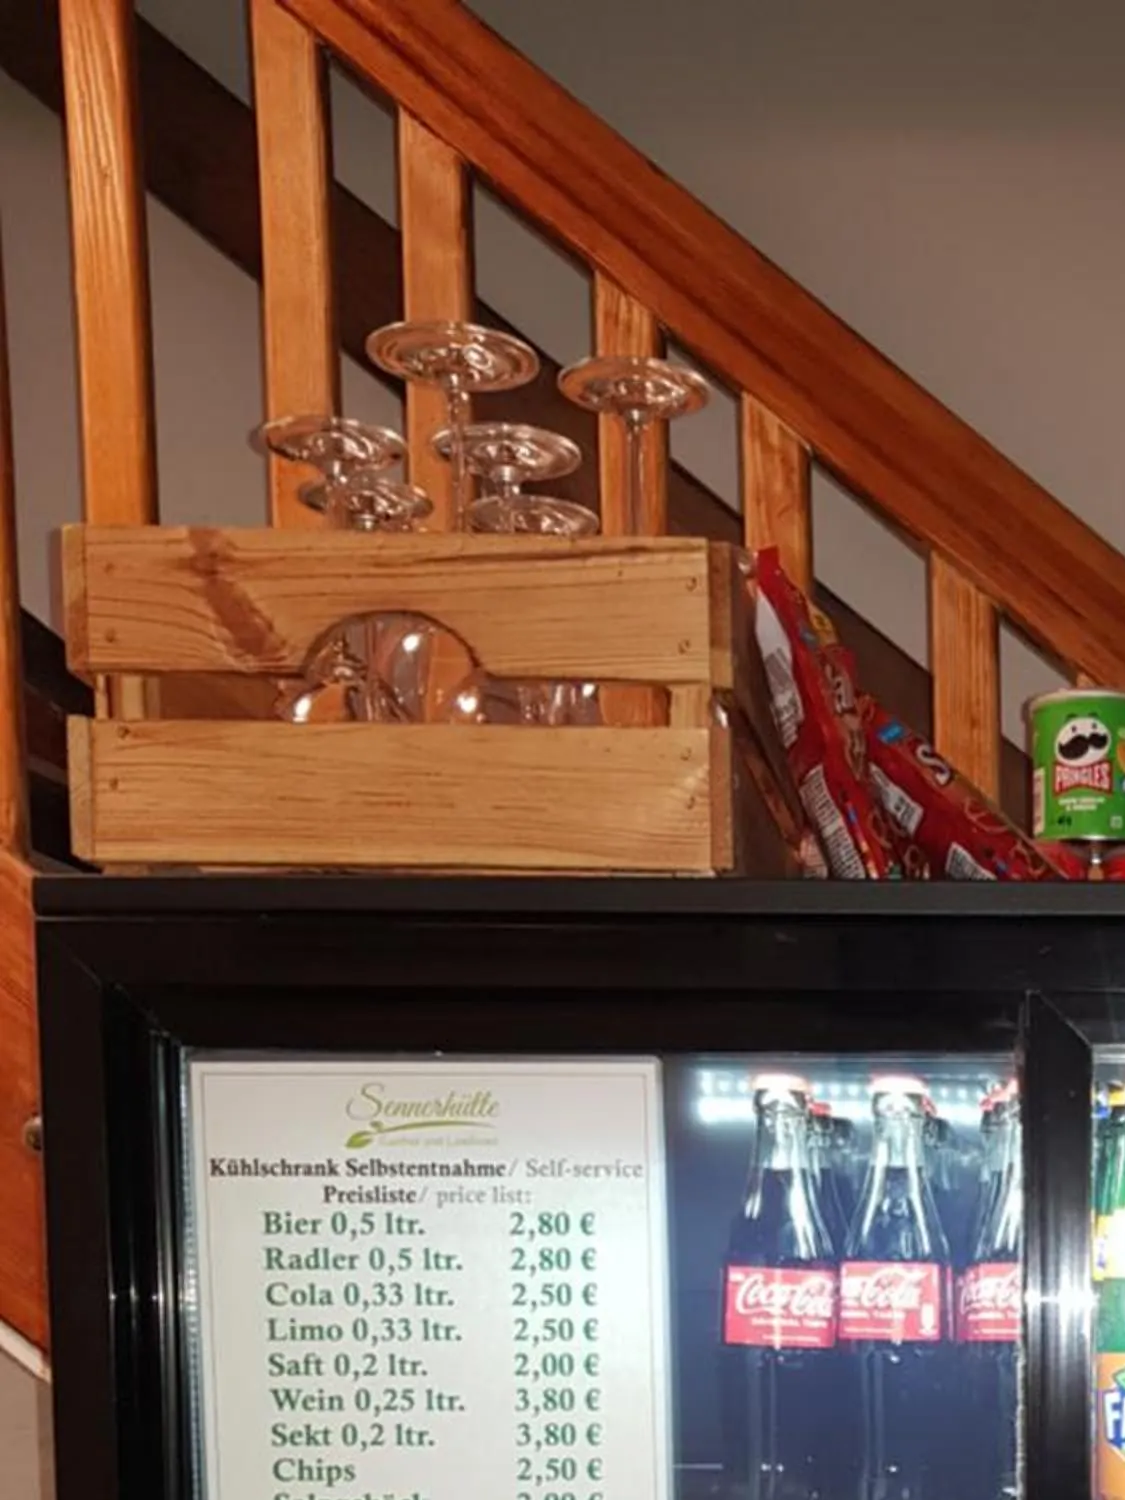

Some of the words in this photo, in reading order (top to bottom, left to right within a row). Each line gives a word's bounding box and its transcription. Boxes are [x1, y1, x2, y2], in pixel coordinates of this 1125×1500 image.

[1055, 762, 1111, 793] PRINGLES
[210, 1158, 341, 1178] Kühlschrank
[526, 1159, 642, 1177] Self-service
[437, 1186, 486, 1206] price
[493, 1186, 530, 1203] list:
[263, 1211, 322, 1235] Bier
[331, 1211, 375, 1241] 0,5
[385, 1211, 425, 1235] ltr.
[510, 1211, 571, 1241] 2,80
[579, 1212, 595, 1236] €
[264, 1247, 360, 1271] Radler
[368, 1247, 412, 1276] 0,5
[423, 1247, 463, 1271] ltr.
[511, 1247, 572, 1276] 2,80
[580, 1247, 596, 1271] €
[265, 1282, 334, 1307] Cola
[343, 1282, 404, 1311] 0,33
[414, 1282, 454, 1306] ltr.
[512, 1282, 572, 1311] 2,50
[581, 1283, 597, 1307] €
[736, 1272, 833, 1317] Coca-Cola
[267, 1318, 344, 1342] Limo
[352, 1317, 412, 1346] 0,33
[421, 1318, 462, 1341] ltr.
[514, 1318, 575, 1346] 2,50
[582, 1318, 598, 1342] €
[268, 1352, 324, 1377] Saft
[334, 1353, 378, 1381] 0,2
[388, 1353, 428, 1376] ltr.
[515, 1352, 575, 1381] 2,00
[583, 1353, 599, 1377] €
[269, 1388, 345, 1412] Wein
[354, 1388, 415, 1417] 0,25
[425, 1388, 465, 1412] ltr.
[515, 1387, 575, 1416] 3,80
[584, 1388, 601, 1411] €
[271, 1423, 332, 1447] Sekt
[341, 1422, 385, 1452] 0,2
[395, 1423, 435, 1446] ltr.
[517, 1422, 577, 1452] 3,80
[585, 1423, 601, 1446] €
[273, 1458, 356, 1488] Chips
[517, 1457, 577, 1487] 2,50
[586, 1458, 602, 1481] €
